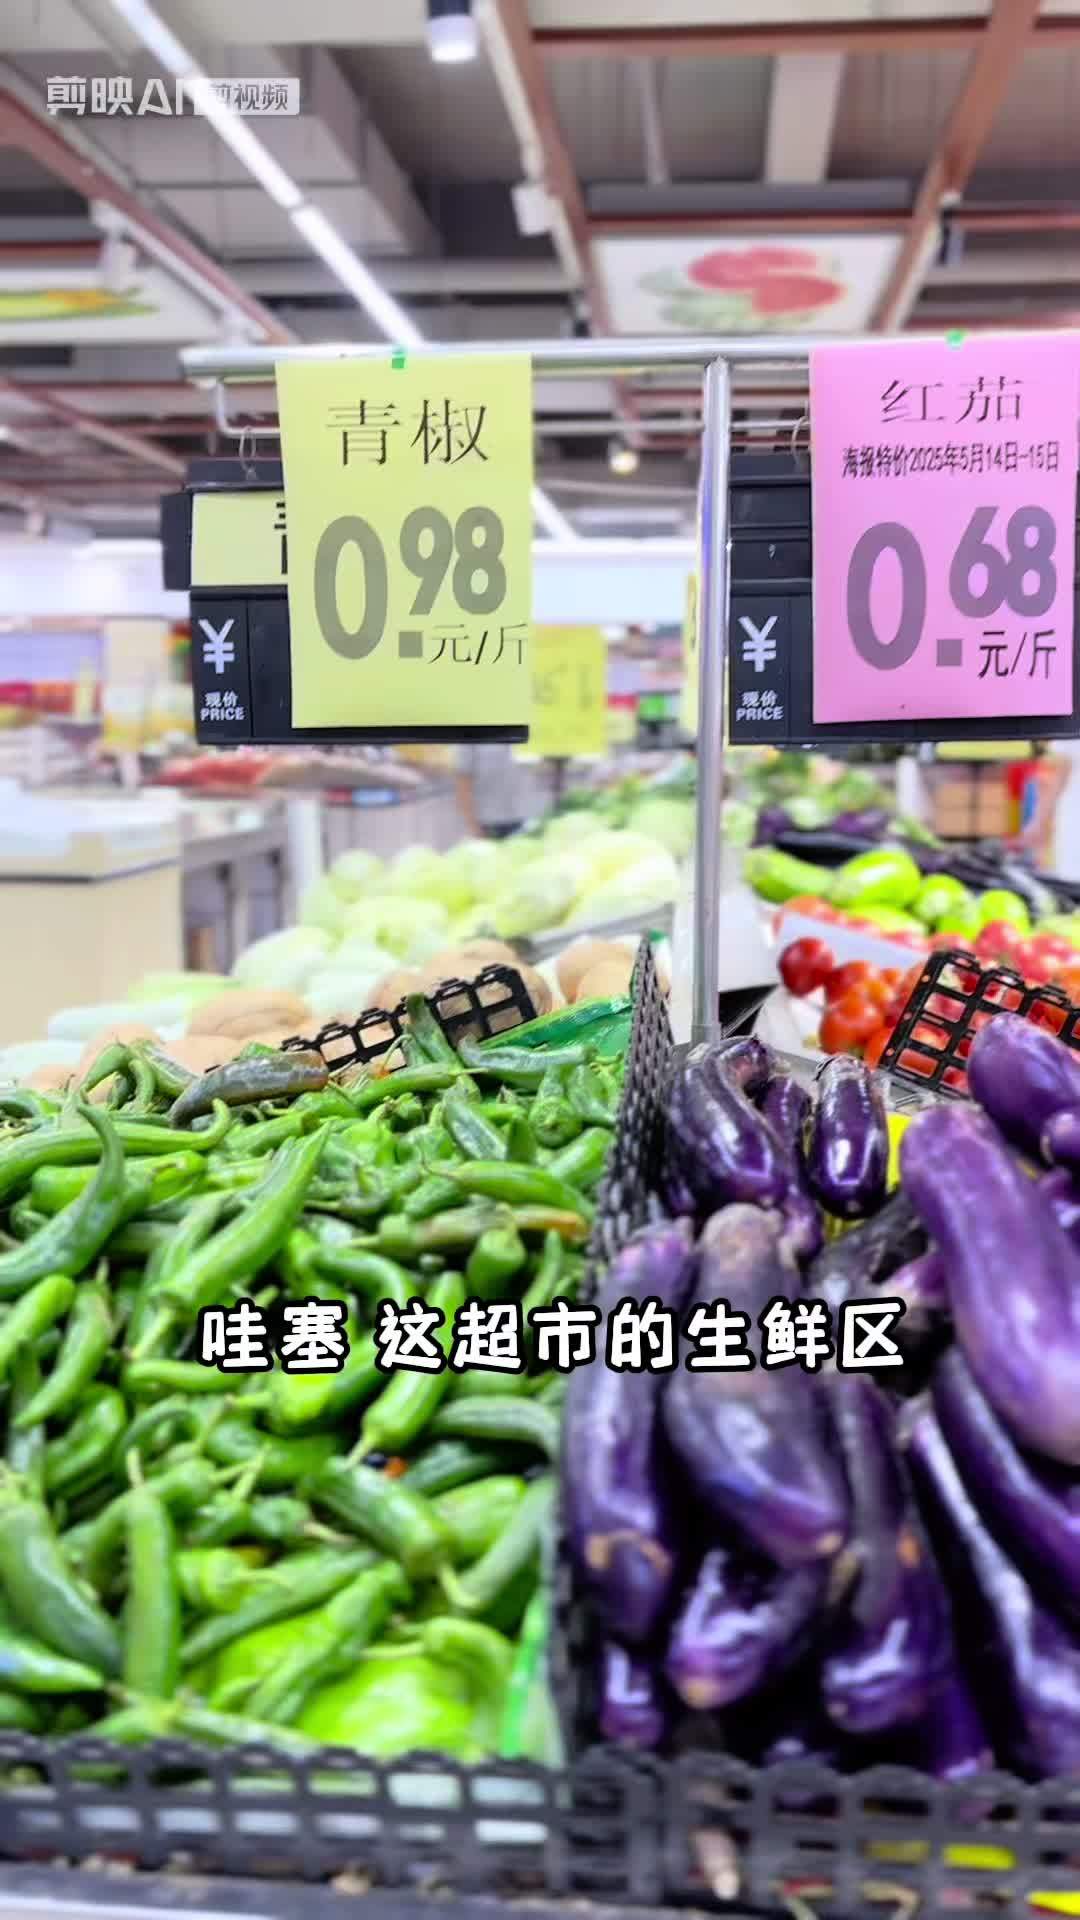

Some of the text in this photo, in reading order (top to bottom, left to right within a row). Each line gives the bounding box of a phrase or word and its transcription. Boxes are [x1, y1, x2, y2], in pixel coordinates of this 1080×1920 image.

[880, 376, 1025, 424] 红茄
[325, 399, 490, 467] 青椒
[313, 506, 507, 660] 0.98
[427, 623, 529, 665] 元/斤
[846, 505, 1057, 680] 0.68 元/斤
[200, 706, 245, 721] PRICE
[736, 705, 784, 721] PRICE
